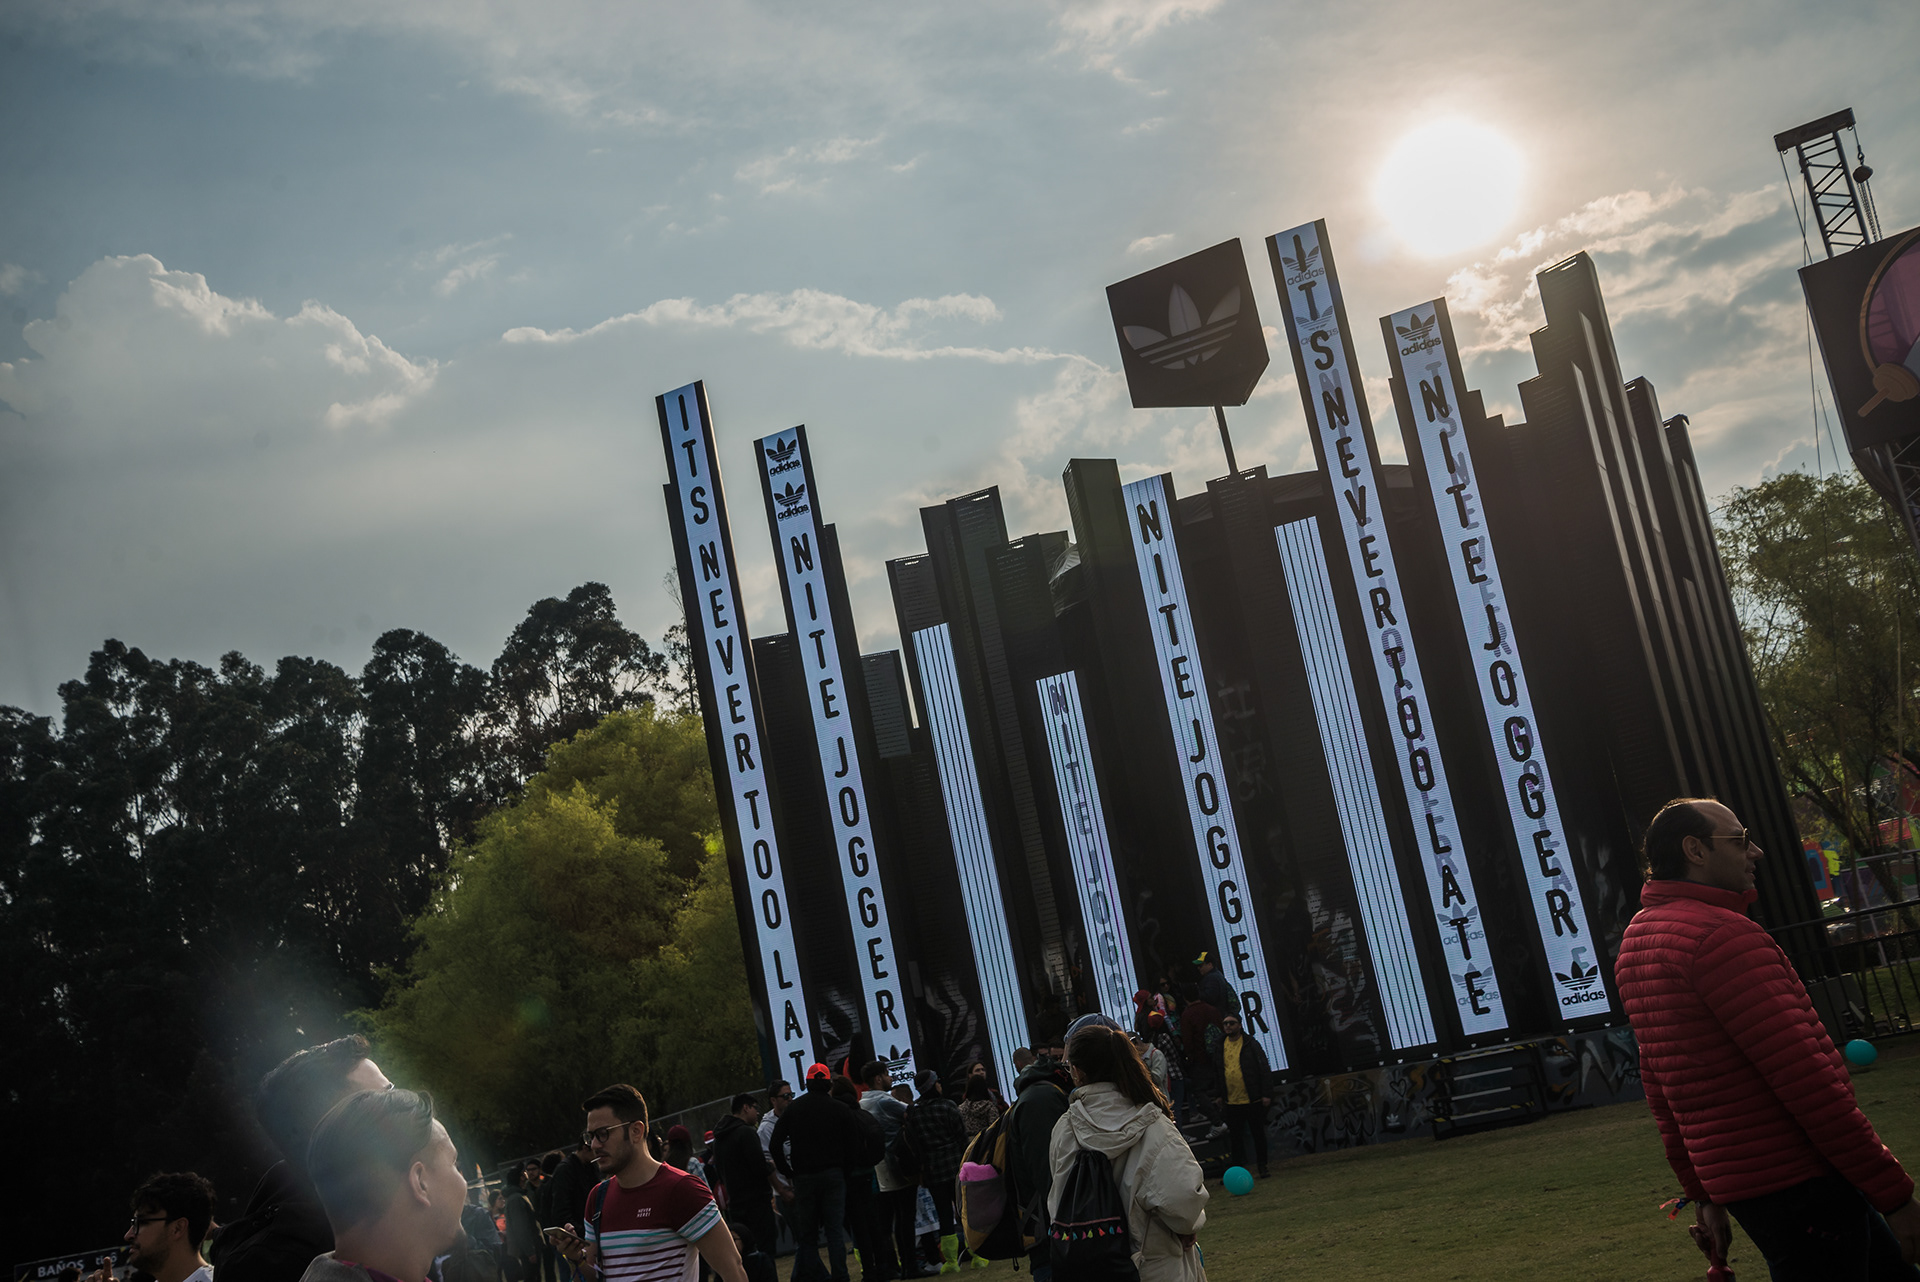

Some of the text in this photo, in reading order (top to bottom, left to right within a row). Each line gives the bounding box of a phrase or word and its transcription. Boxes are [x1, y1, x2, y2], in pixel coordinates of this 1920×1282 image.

[770, 460, 801, 475] adidas
[778, 504, 809, 520] adidas
[1401, 337, 1441, 356] adidas
[678, 394, 709, 525] ITS
[698, 541, 755, 773] NEVER
[743, 789, 782, 929] TOO
[790, 533, 900, 1032] NITE JOGGER
[1136, 500, 1195, 699] NITE
[1190, 718, 1269, 1034] JOGGER
[1292, 234, 1334, 370] ITS
[1321, 387, 1398, 629] NEVER
[1383, 646, 1435, 791] TOO
[1425, 813, 1491, 1016] LATE
[1419, 375, 1488, 584] NITE
[1484, 604, 1578, 937] JOGGER
[1562, 990, 1605, 1006] adidas
